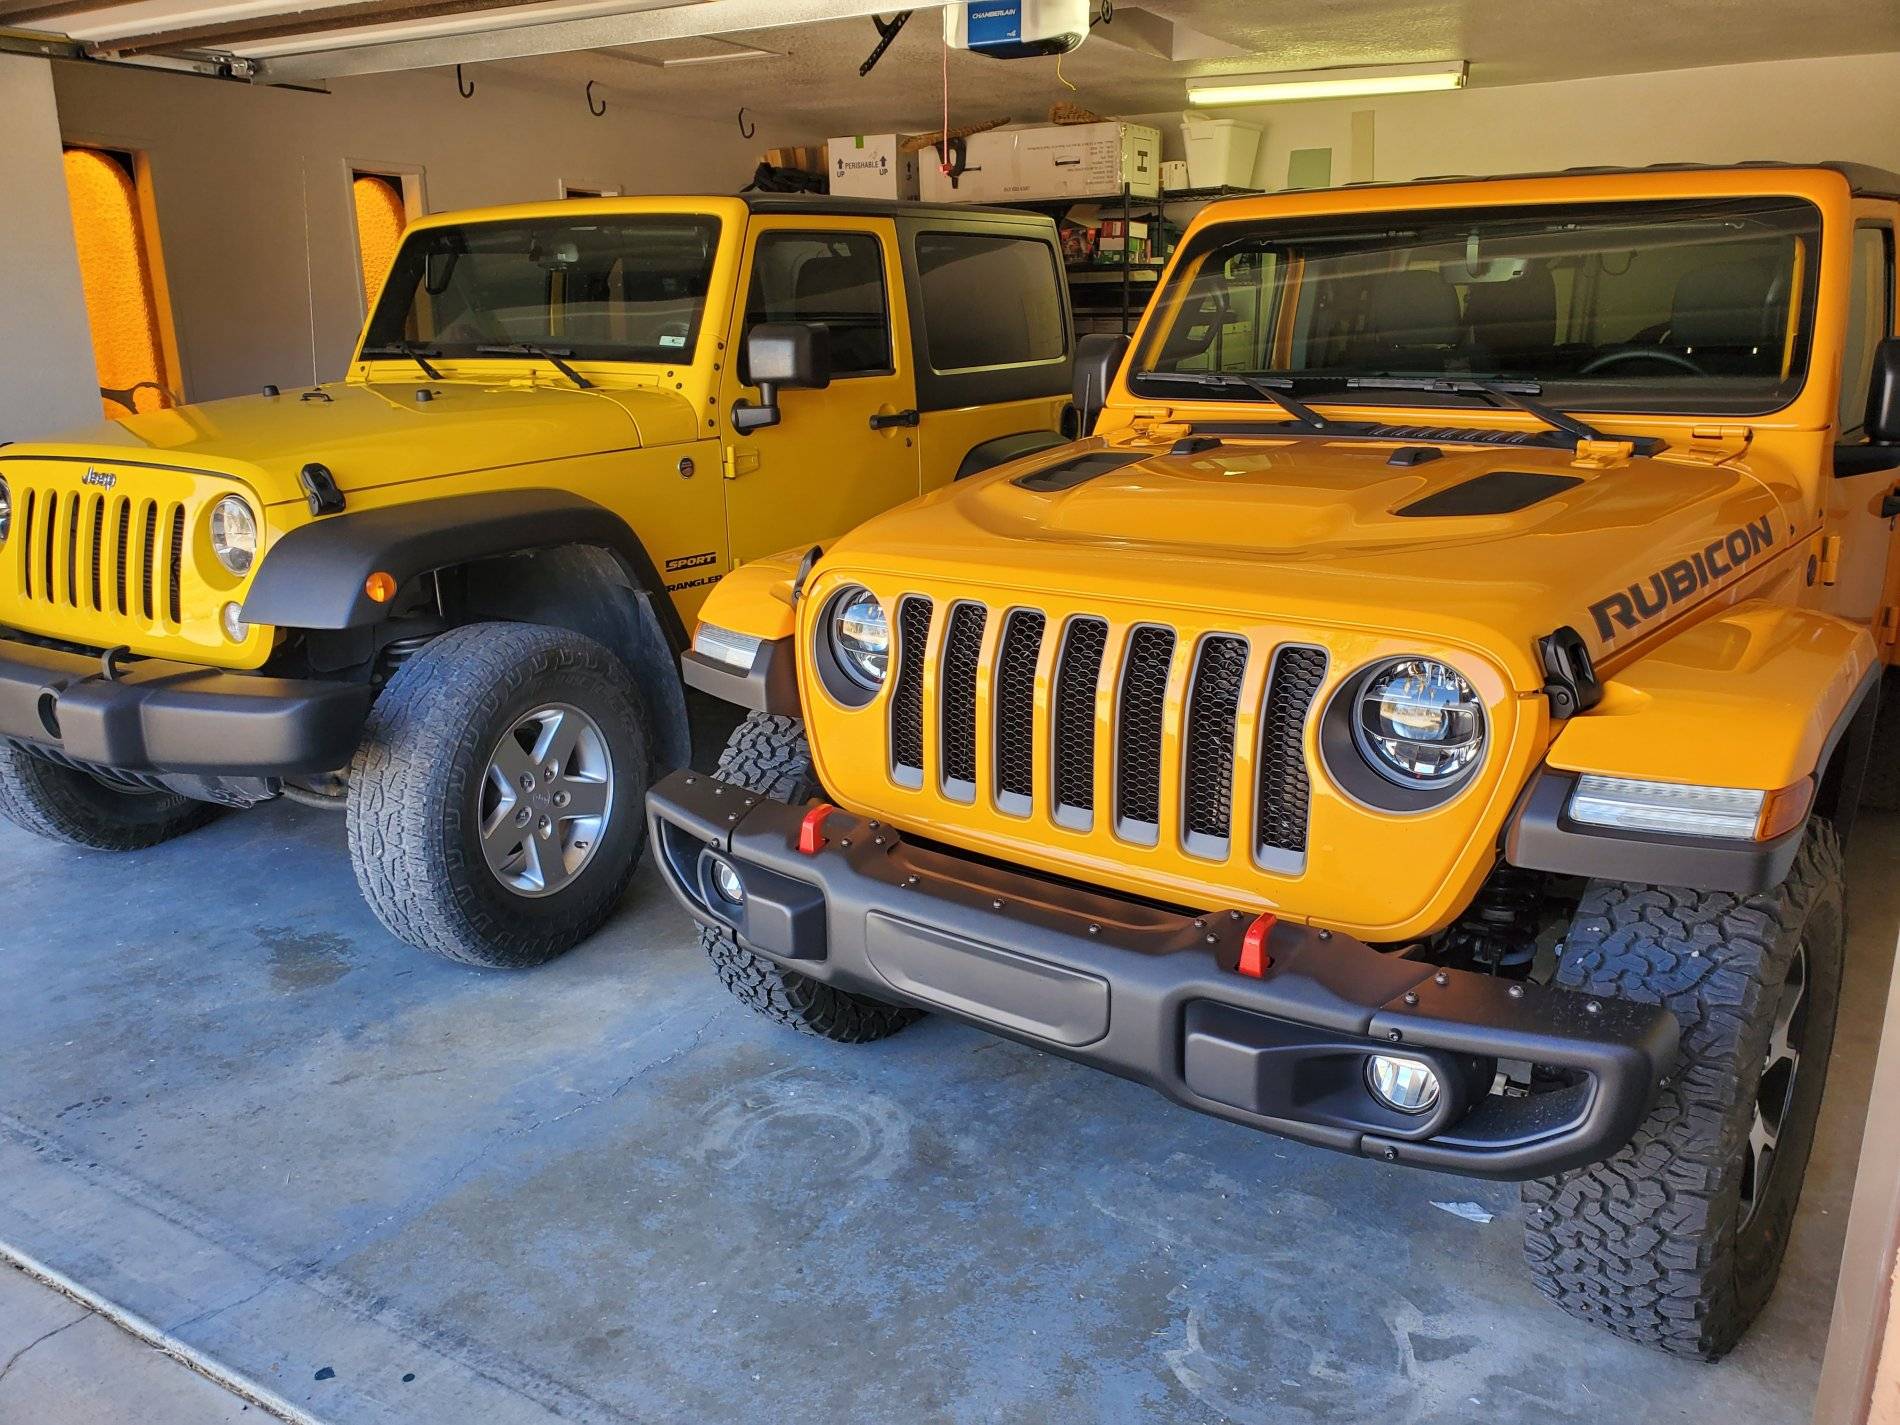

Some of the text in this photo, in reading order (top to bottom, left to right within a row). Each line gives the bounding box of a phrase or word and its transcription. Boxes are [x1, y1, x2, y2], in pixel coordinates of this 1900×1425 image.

[972, 9, 1016, 18] CHAMBERLAIN
[845, 160, 879, 169] PERISHABLE
[879, 168, 888, 176] UP
[82, 464, 117, 491] Jeep
[668, 555, 714, 568] SPORT
[664, 574, 723, 592] RANGLER
[1587, 514, 1774, 643] RUBICON
